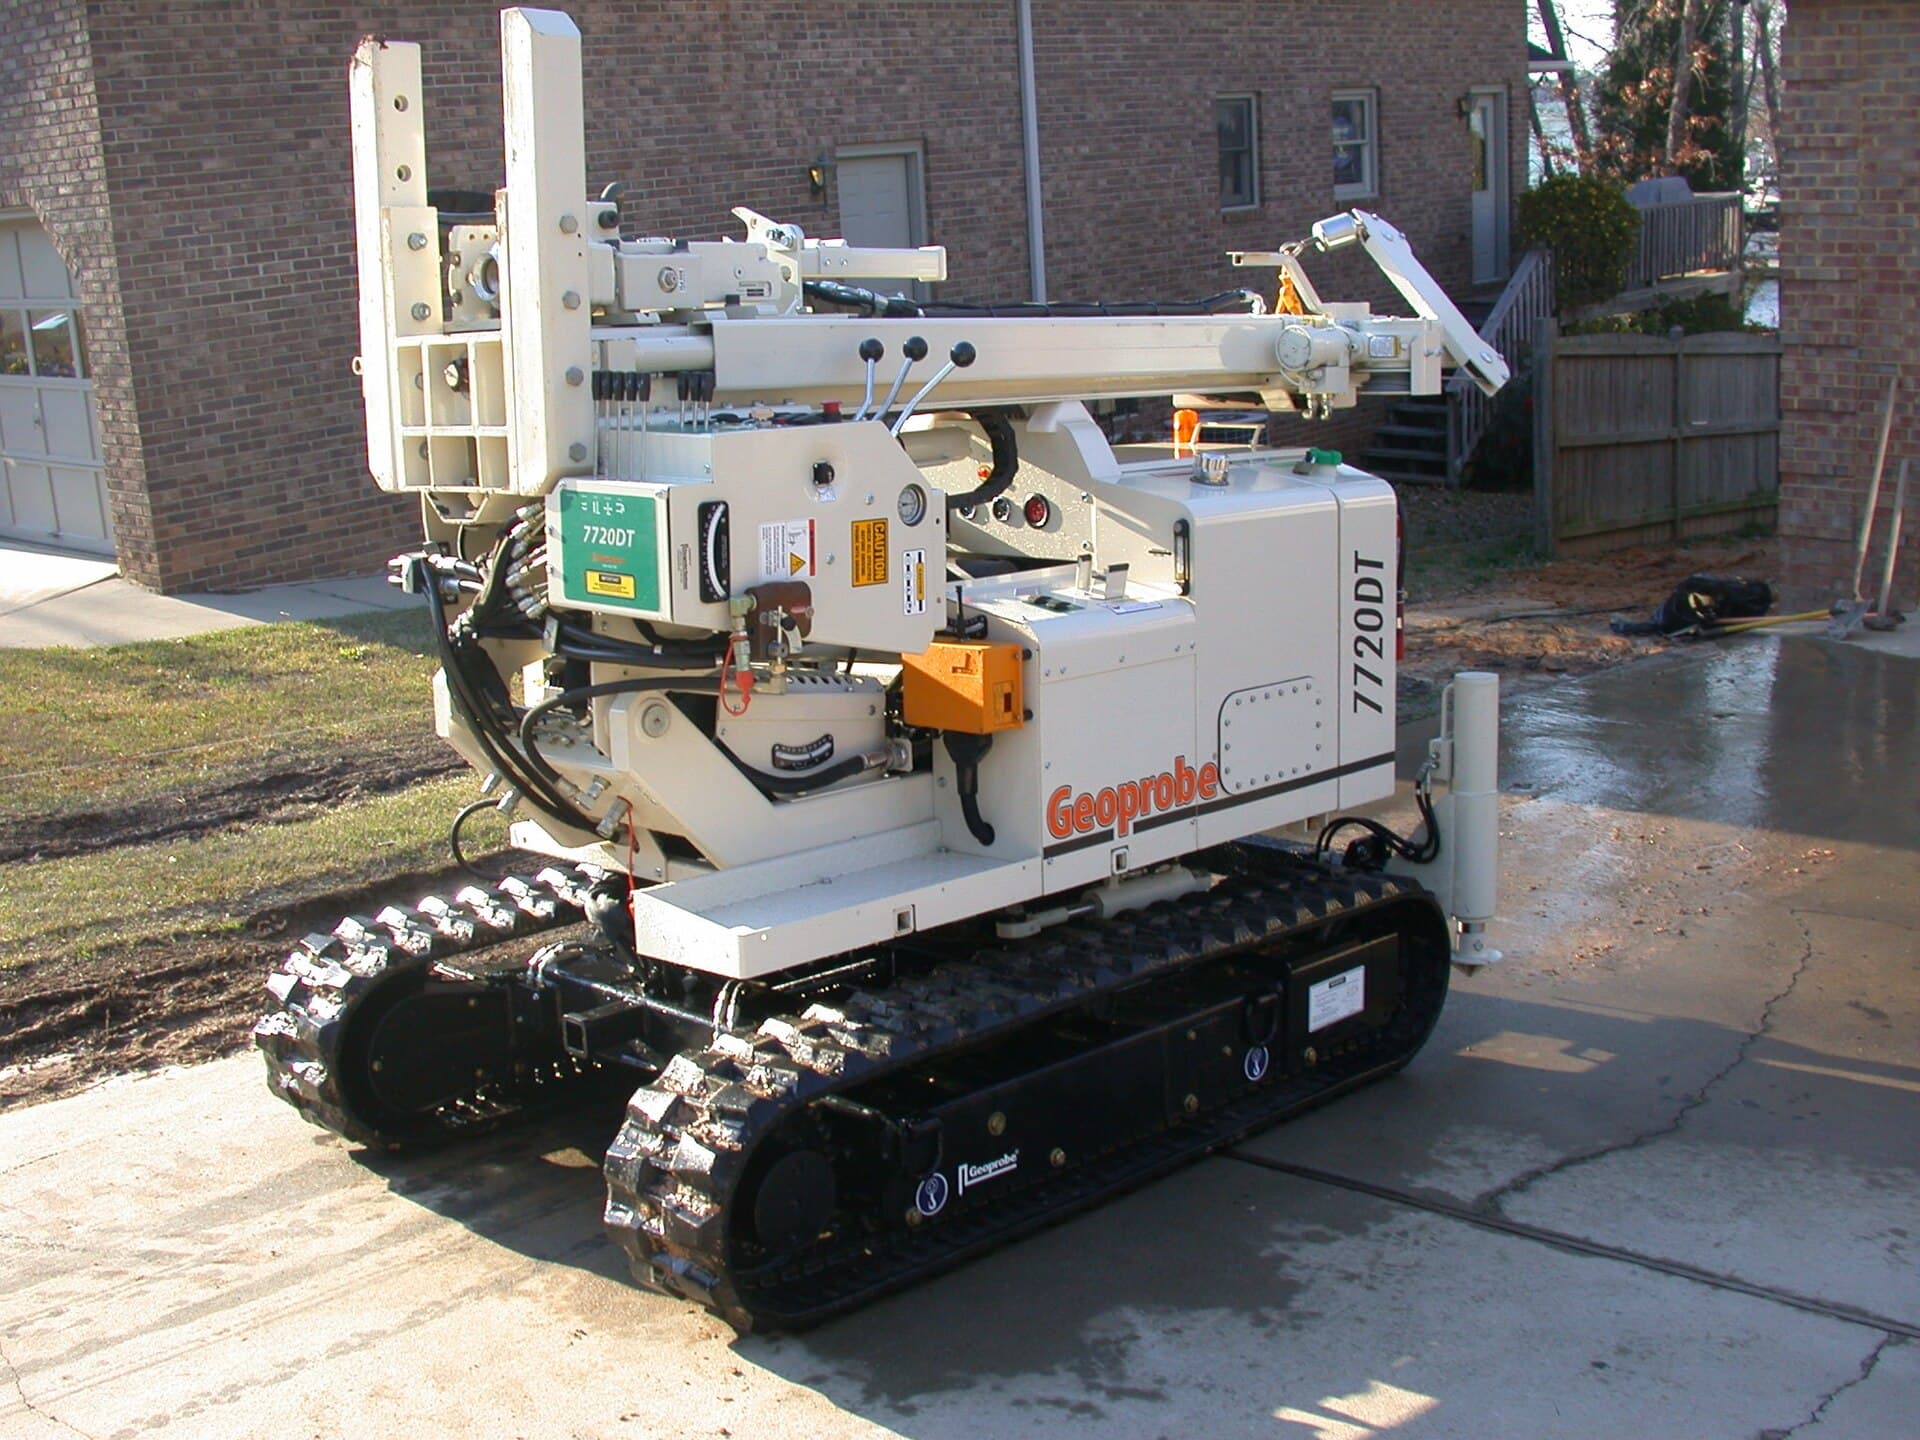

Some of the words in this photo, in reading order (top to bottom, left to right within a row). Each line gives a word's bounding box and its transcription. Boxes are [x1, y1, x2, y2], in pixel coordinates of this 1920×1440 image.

[583, 525, 635, 548] 7720DT
[874, 523, 885, 580] CAUTION
[1353, 550, 1384, 714] 7720DT
[1047, 755, 1218, 839] Geoprobe
[969, 1153, 1018, 1177] Geoprobe
